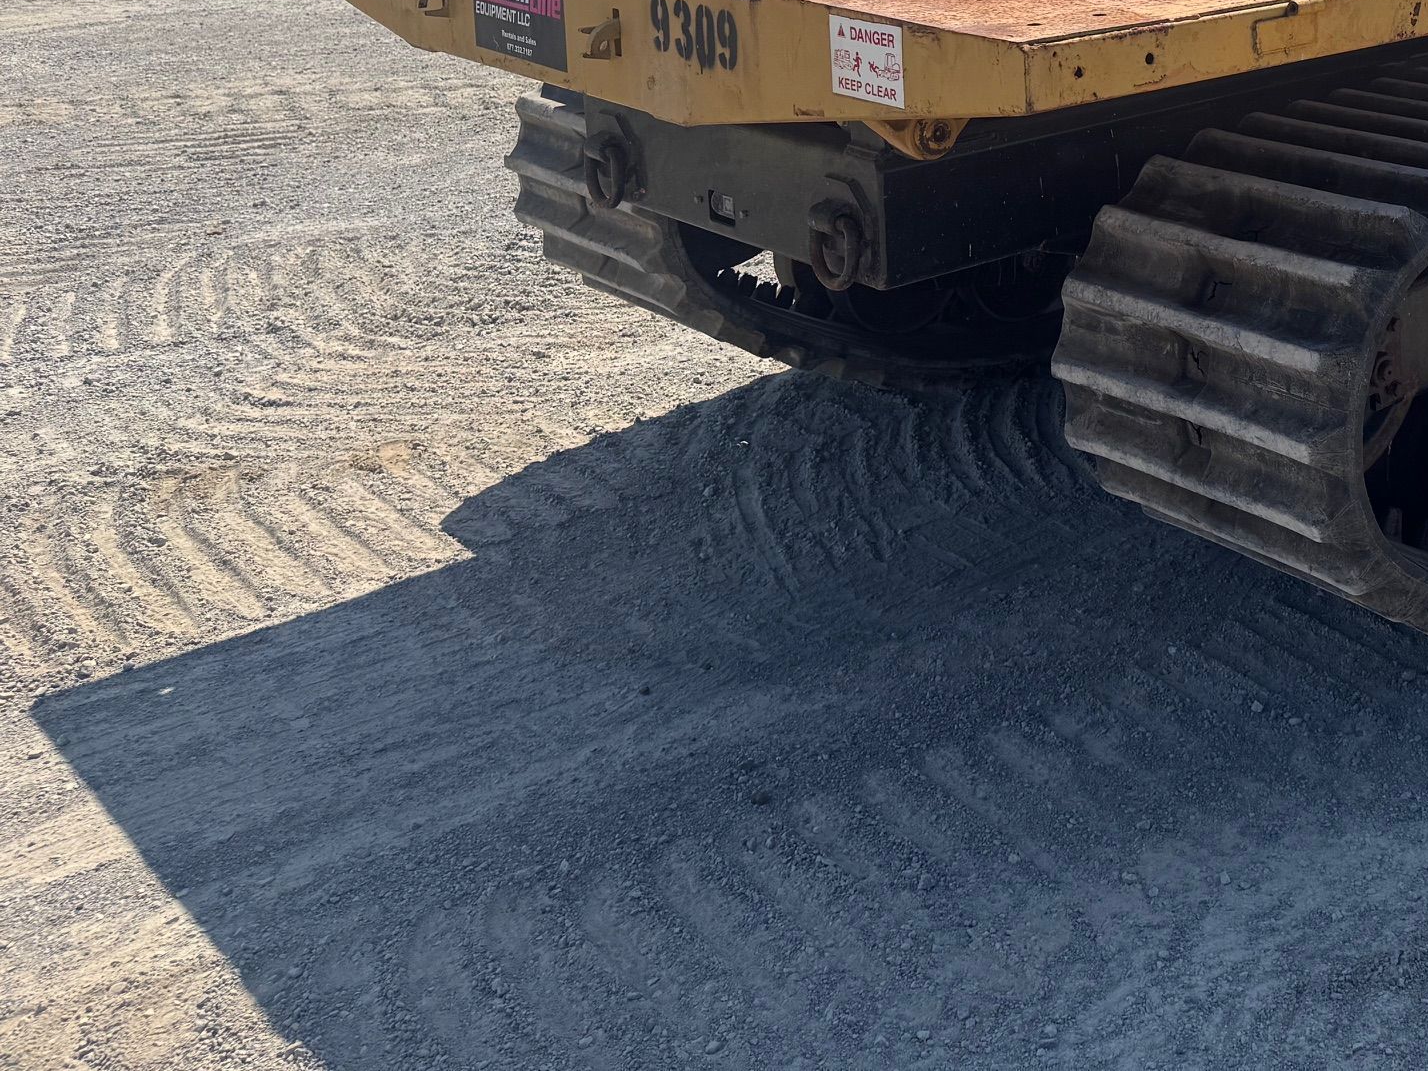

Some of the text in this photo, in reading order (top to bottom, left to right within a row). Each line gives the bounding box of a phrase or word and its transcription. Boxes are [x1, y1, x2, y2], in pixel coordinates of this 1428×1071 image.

[476, 0, 531, 27] EQUIPMENT LLC
[502, 29, 537, 46] Rentals and Sales
[850, 26, 895, 49] DANGER
[838, 76, 897, 102] KEEP CLEAR
